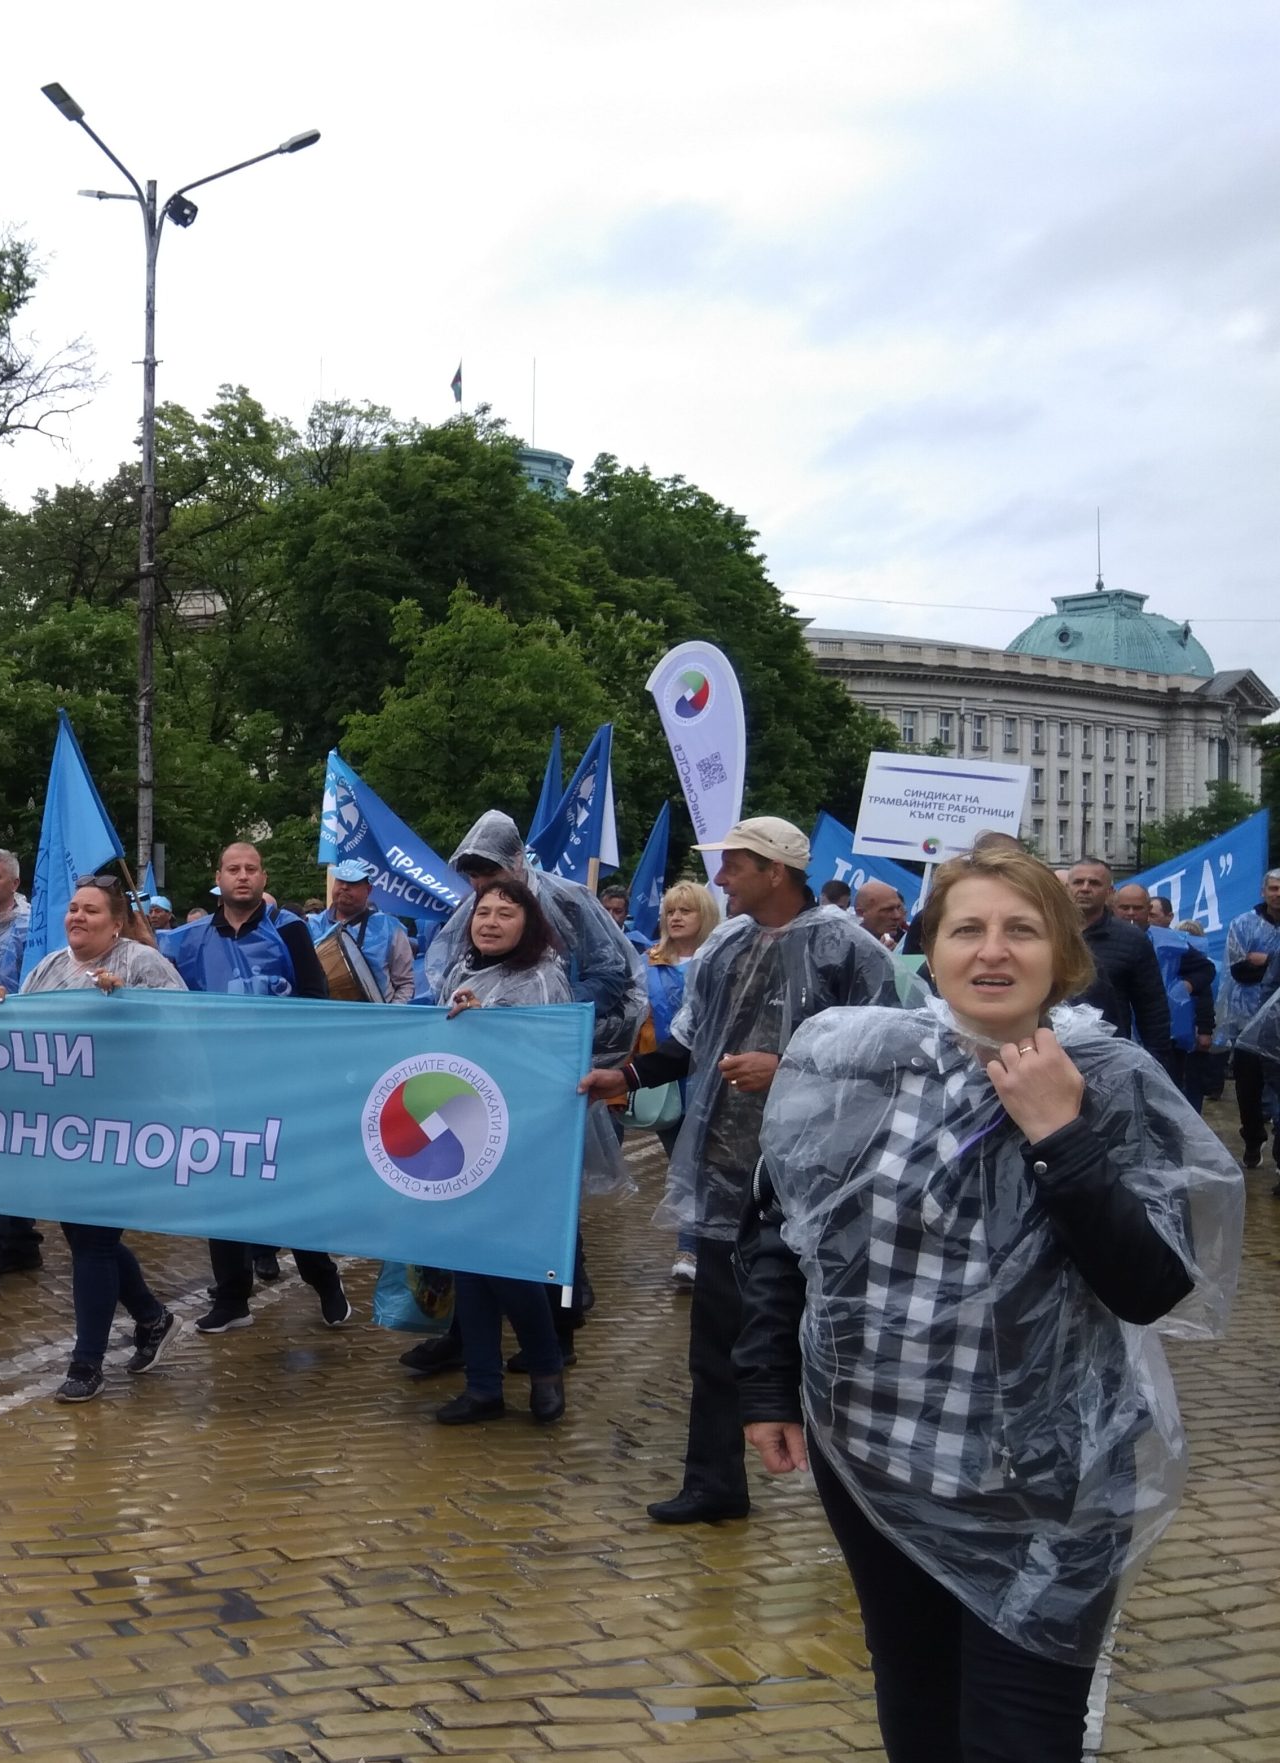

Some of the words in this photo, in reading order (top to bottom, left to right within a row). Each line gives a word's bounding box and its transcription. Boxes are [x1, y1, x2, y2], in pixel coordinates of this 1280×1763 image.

[868, 795, 945, 811] ТРАМВАЙНИТЕ
[947, 804, 1015, 819] РАБОТНИЦИ
[903, 788, 963, 802] СИНДИКАТ
[964, 794, 980, 804] НА
[909, 810, 935, 820] КЪМ
[937, 812, 966, 824] СТСБ
[367, 1059, 446, 1139] ТРАНСПОРТНИТЕ
[448, 1061, 502, 1131] СИНДИКАТИ
[489, 1134, 501, 1145] В
[371, 1142, 387, 1163] НА
[382, 1163, 421, 1193] СЪЮЗ
[432, 1147, 497, 1195] БЪЛГАРИЯ
